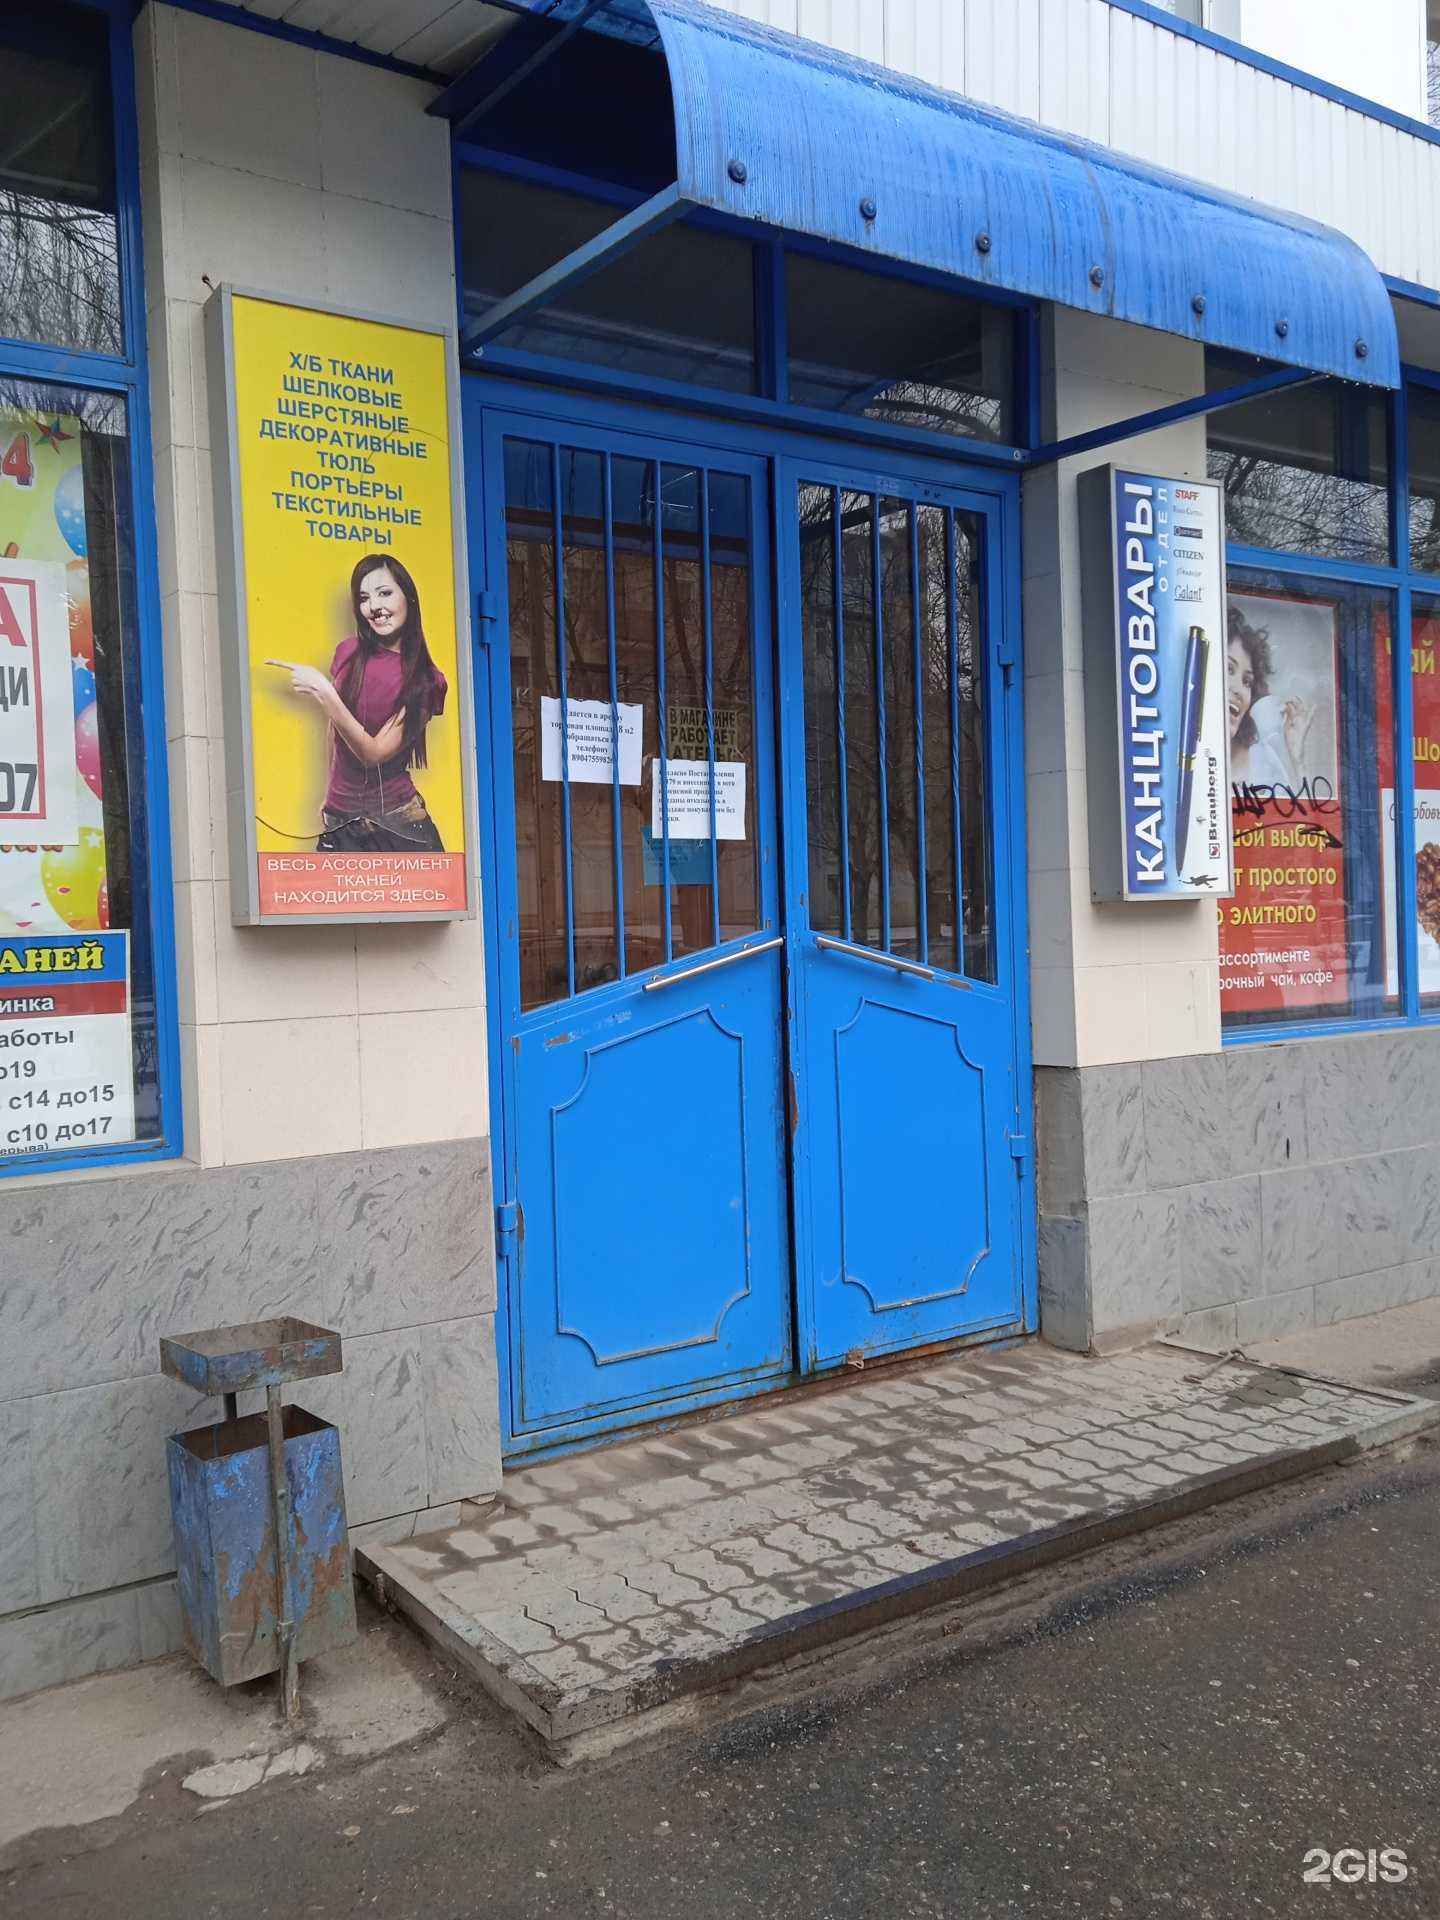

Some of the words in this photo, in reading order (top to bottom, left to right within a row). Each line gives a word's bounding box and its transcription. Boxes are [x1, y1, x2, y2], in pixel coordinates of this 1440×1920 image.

[289, 351, 322, 373] Х/Б
[328, 359, 394, 384] ТКАНИ
[283, 374, 402, 409] ШЕЛКОВЫЕ
[277, 398, 409, 434] ШЕРСТЯНЫЕ
[259, 418, 427, 459] ДЕКОРАТИВНЫЕ
[317, 451, 375, 474] ТЮЛЬ
[290, 471, 403, 501] ПОРТЬЕРЫ
[1175, 489, 1201, 501] STAFF
[272, 492, 422, 526] ТЕКСТИЛЬНЫЕ
[306, 520, 392, 546] ТОВАРЫ
[1158, 487, 1169, 593] ОТДЕЛ
[1173, 549, 1205, 561] CITIZEN
[1174, 584, 1204, 602] Galant
[1124, 483, 1167, 882] КАНЦТОВАРЫ
[680, 709, 736, 729] МАГАИНЕ
[670, 727, 736, 745] РАБОАЕТ
[1208, 756, 1217, 841] Brauberg
[1271, 823, 1328, 852] выбор
[267, 858, 317, 871] ВЕСЬ
[321, 858, 452, 871] АССОРТИМЕНТ
[334, 871, 402, 886] ТКАНЕЙ
[1249, 867, 1337, 891] простого
[274, 890, 385, 904] НАХОДИТСЯ
[390, 888, 449, 903] ЗДЕСЬ.
[1230, 904, 1317, 926] элитного
[1300, 967, 1334, 989] кофе
[9, 1090, 50, 1110] с14
[57, 1085, 114, 1109] до15
[7, 1123, 48, 1144] с10
[55, 1117, 113, 1142] до17
